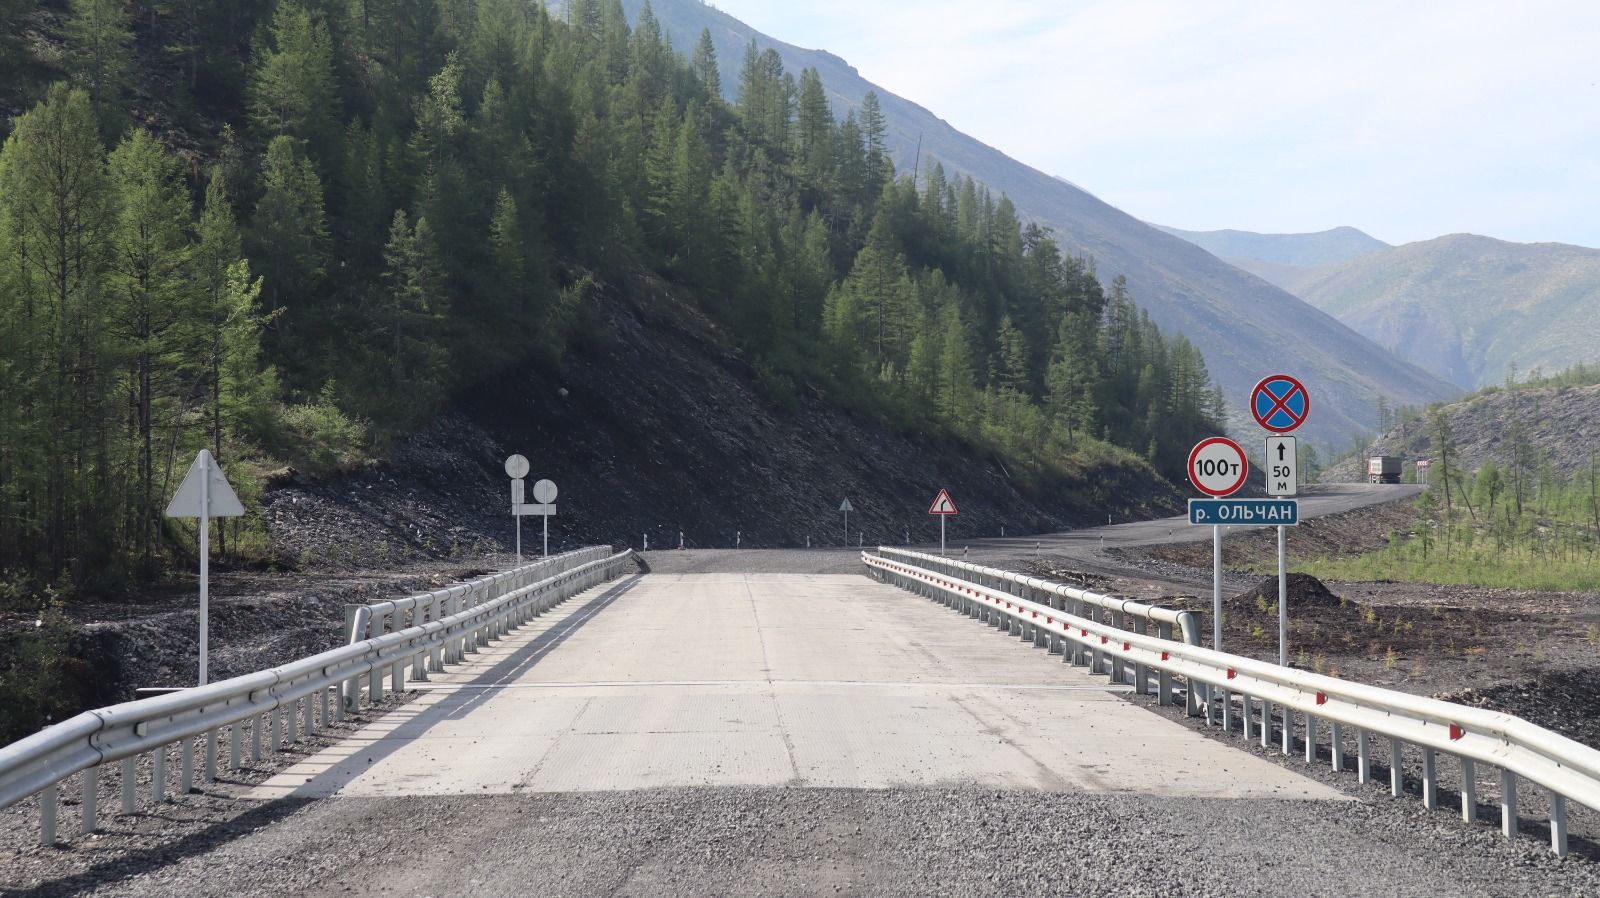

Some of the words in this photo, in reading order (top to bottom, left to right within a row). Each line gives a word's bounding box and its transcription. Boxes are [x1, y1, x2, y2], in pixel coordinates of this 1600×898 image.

[1196, 459, 1239, 476] 100т
[1273, 466, 1291, 478] 50
[1195, 508, 1210, 523] р.
[1218, 505, 1292, 520] ОЛЬЧАН
